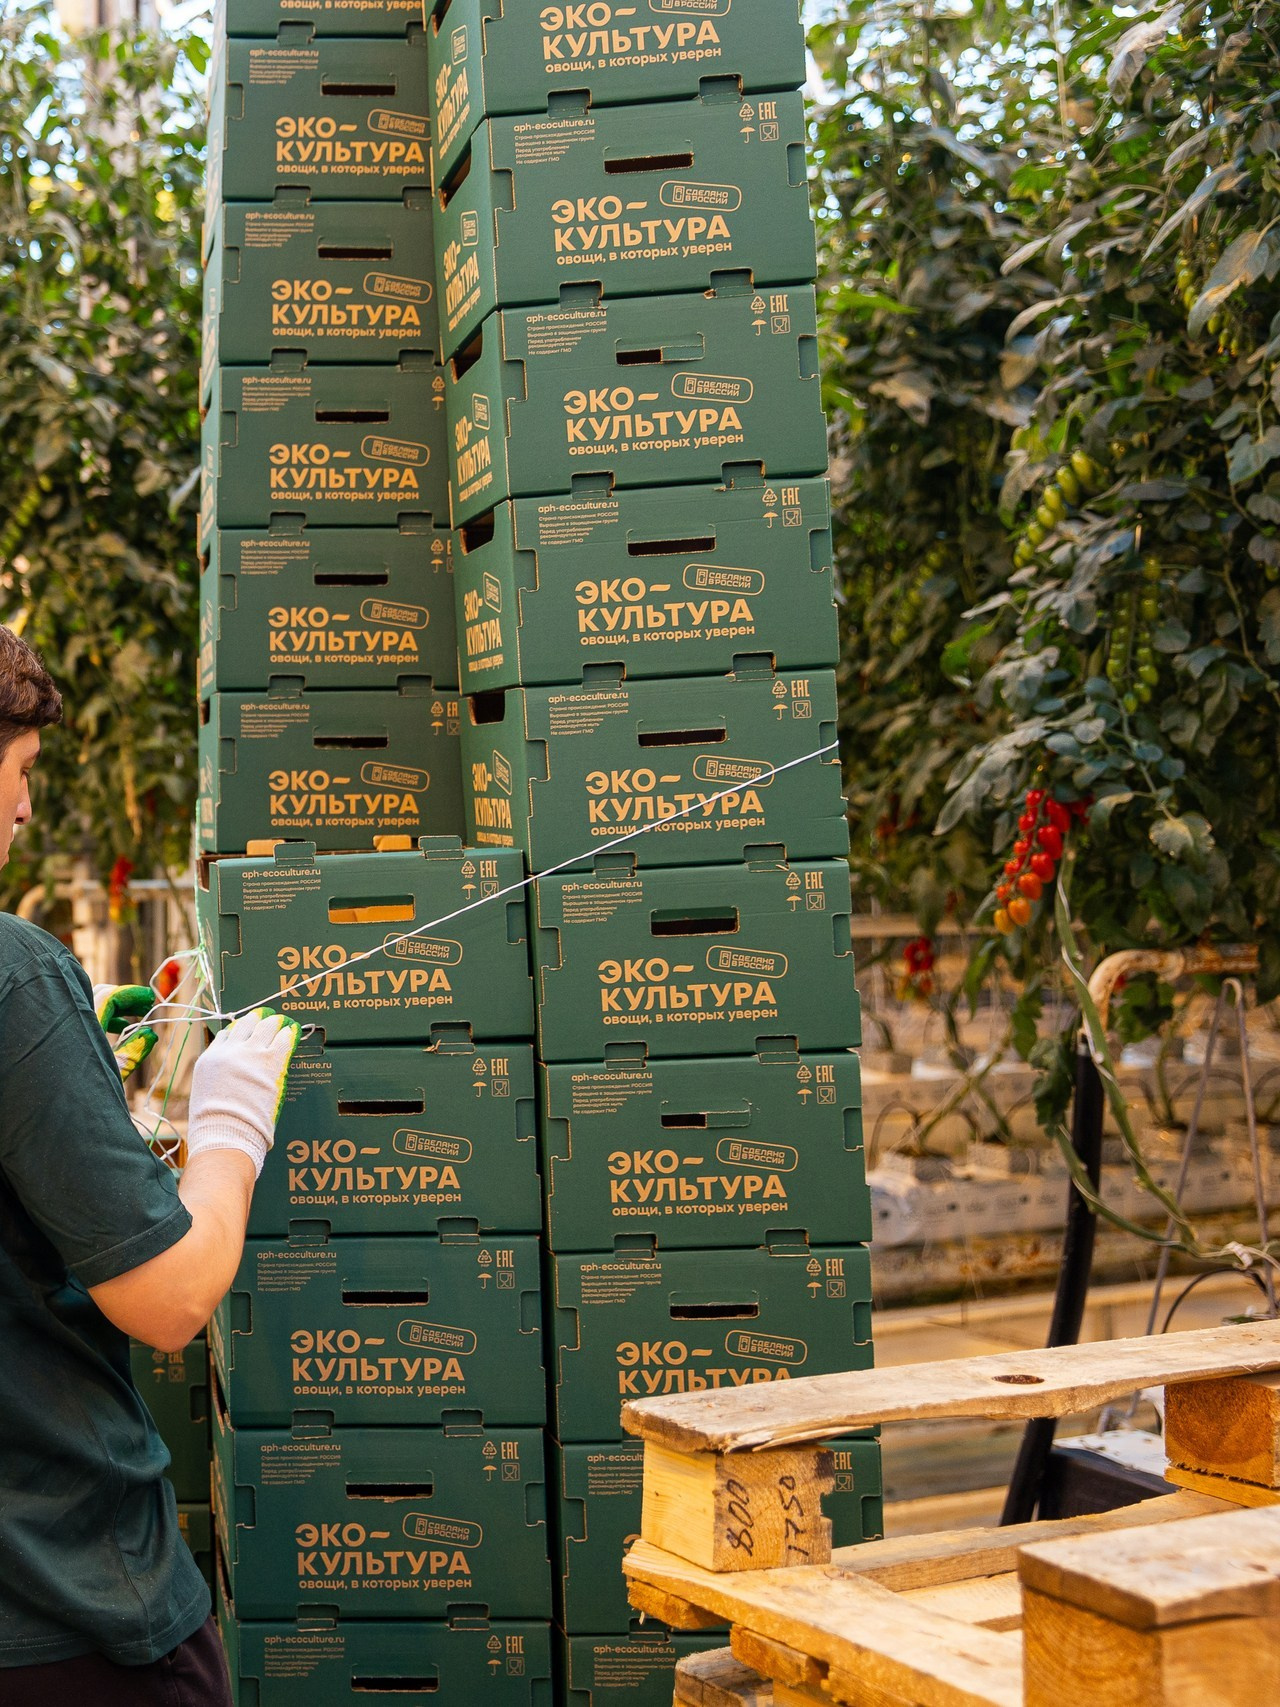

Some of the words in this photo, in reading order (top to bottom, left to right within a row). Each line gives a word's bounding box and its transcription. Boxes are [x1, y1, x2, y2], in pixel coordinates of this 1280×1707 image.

[280, 0, 322, 10] овощи,
[325, 0, 332, 9] в
[334, 0, 384, 11] которых
[386, 0, 421, 12] увере
[543, 20, 719, 60] КУЛЬТУРА
[544, 61, 594, 72] овощи,
[598, 59, 606, 68] в
[610, 53, 668, 66] которых
[671, 49, 722, 63] уверен
[514, 119, 595, 133] aph-ecoculture.ru
[277, 141, 424, 162] КУЛЬТУРА
[276, 165, 318, 173] овощи,
[331, 165, 380, 175] которых
[383, 166, 425, 175] уверен
[555, 215, 730, 252] КУЛЬТУРА
[556, 253, 605, 264] овощи,
[610, 252, 617, 260] в
[621, 247, 678, 260] которых
[682, 243, 732, 257] уверен
[273, 304, 420, 325] КУЛЬТУРА
[526, 310, 607, 324] aph-ecoculture.ru
[567, 407, 741, 442] КУЛЬТУРА
[568, 444, 617, 455] овощи,
[621, 443, 629, 451] в
[632, 438, 690, 451] которых
[693, 435, 744, 448] уверен
[271, 468, 418, 488] КУЛЬТУРА
[538, 501, 618, 514] aph-ecoculture.ru
[709, 574, 751, 582] СДЕЛАНО
[578, 599, 753, 632] КУЛЬТУРА
[270, 631, 418, 651] КУЛЬТУРА
[465, 618, 503, 657] КУЛЬТУРА
[580, 635, 628, 645] овощи,
[633, 634, 640, 642] в
[644, 630, 701, 642] которых
[705, 627, 755, 640] уверен
[548, 692, 629, 705] aph-ecoculture.ru
[271, 794, 419, 815] КУЛЬТУРА
[474, 797, 513, 829] КУЛЬТУРА
[589, 790, 763, 823] КУЛЬТУРА
[271, 818, 312, 826] овощи,
[326, 818, 375, 827] которых
[378, 818, 420, 827] уверен
[590, 825, 638, 835] овощи
[654, 821, 712, 833] которых
[715, 818, 765, 831] уверен
[242, 868, 321, 880] aph-ecoculture.ru
[562, 880, 643, 893] aph-ecoculture.ru
[280, 968, 451, 998] КУЛЬТУРА
[281, 1001, 329, 1010] овощи,
[333, 1000, 340, 1008] в
[344, 998, 400, 1009] которых
[404, 996, 453, 1008] уверен
[601, 981, 776, 1012] КУЛЬТУРА
[602, 1015, 651, 1024] овощи,
[656, 1014, 663, 1022] в
[667, 1011, 724, 1023] которых
[728, 1009, 778, 1022] уверен
[290, 1061, 332, 1069] culture.ru
[571, 1071, 653, 1083] aph-ecoculture.ru
[419, 1140, 459, 1150] СДЕЛАНО
[289, 1166, 460, 1191] КУЛЬТУРА
[611, 1175, 786, 1203] КУЛЬТУРА
[289, 1196, 337, 1205] овощи,
[342, 1195, 349, 1203] в
[353, 1194, 409, 1205] которых
[413, 1193, 462, 1205] уверен
[611, 1207, 660, 1216] овощи,
[665, 1206, 672, 1214] в
[676, 1204, 734, 1216] которых
[738, 1203, 788, 1215] уверен
[257, 1250, 337, 1260] aph-ecoculture.ru
[580, 1262, 662, 1273] aph-ecoculture.ru
[293, 1357, 464, 1382] КУЛЬТУРА
[293, 1386, 341, 1395] овощи,
[346, 1386, 353, 1394] в
[357, 1385, 413, 1397] которых
[417, 1385, 466, 1397] уверен
[261, 1443, 341, 1453] aph-ecoculture.ru
[587, 1453, 644, 1463] aph-ecocult
[726, 1478, 754, 1557] 800
[778, 1475, 810, 1556] 1750
[298, 1551, 471, 1576] КУЛЬТУРА
[299, 1580, 347, 1589] овощи,
[352, 1580, 359, 1588] в
[363, 1579, 420, 1591] которых
[423, 1579, 473, 1590] уверен
[593, 1644, 676, 1655] aph-ecoculture.ru
